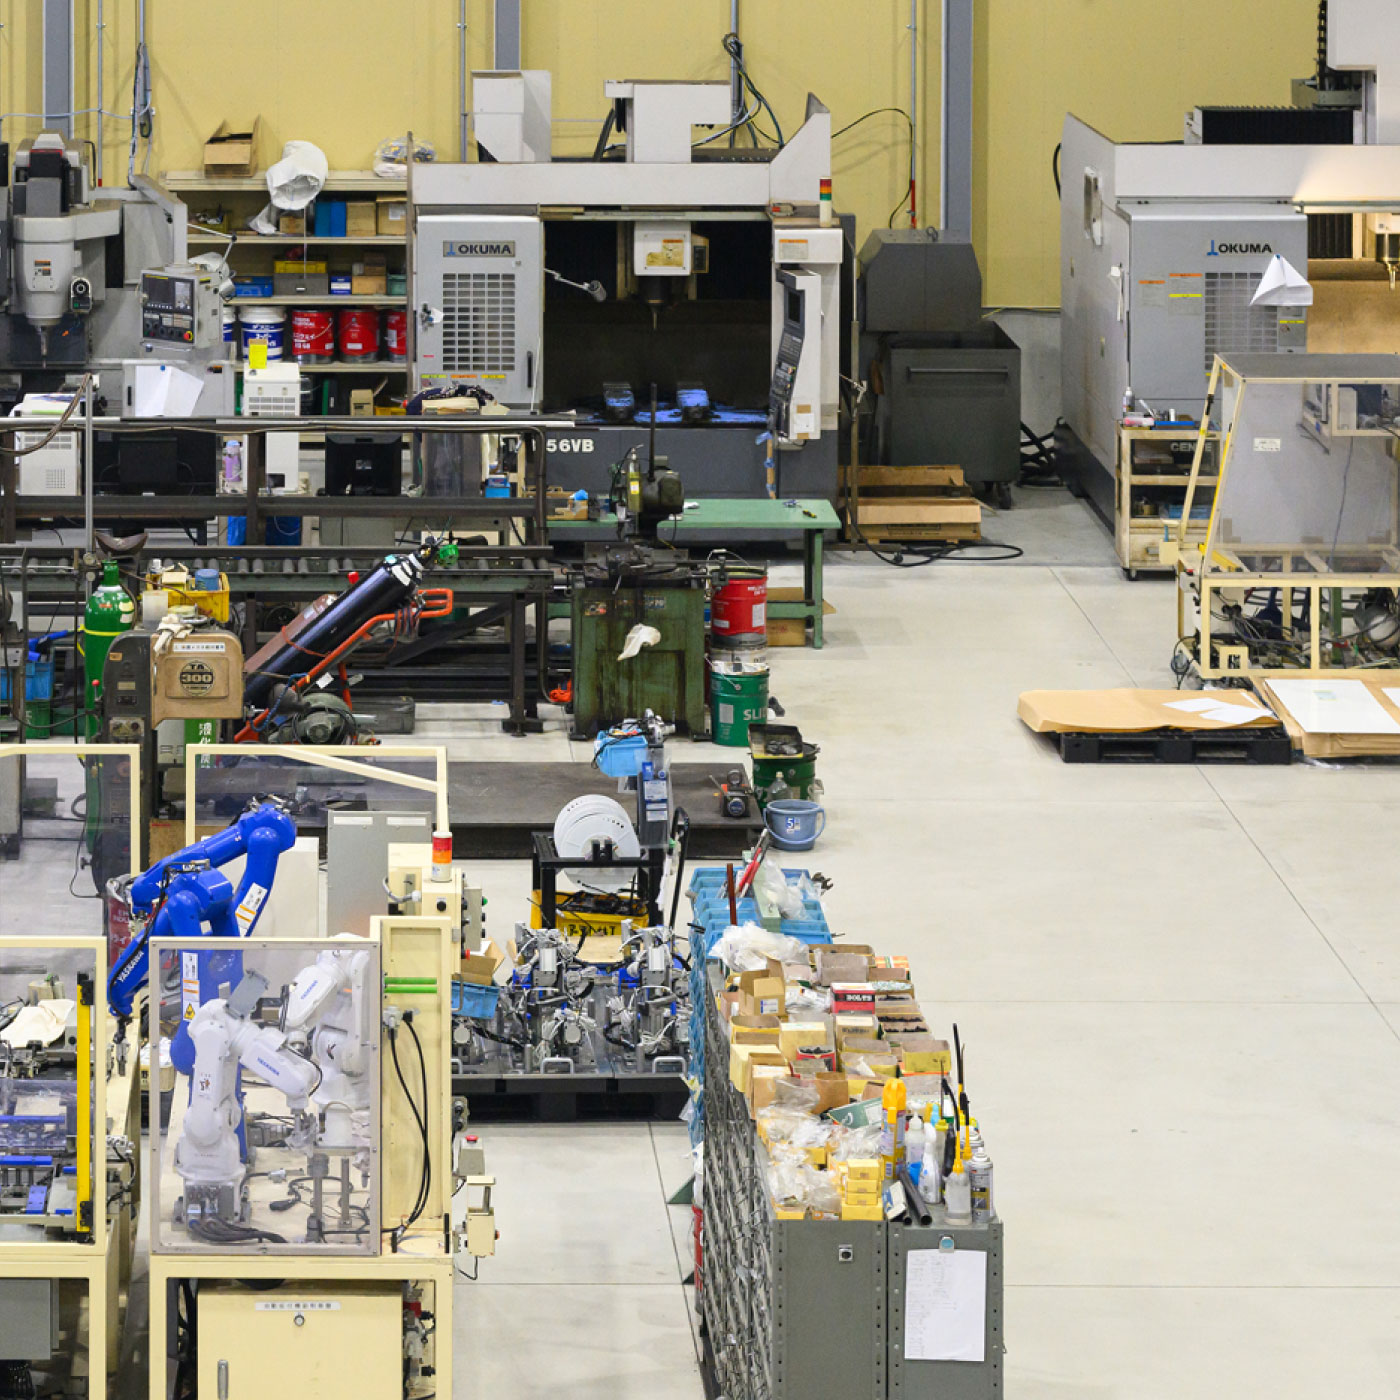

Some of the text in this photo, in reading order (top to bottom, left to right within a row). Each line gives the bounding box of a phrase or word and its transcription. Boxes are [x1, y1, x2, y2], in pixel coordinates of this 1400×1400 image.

[458, 244, 512, 255] OKUMA
[1218, 243, 1273, 253] OKUMA
[182, 674, 212, 682] 300
[787, 817, 794, 829] 5
